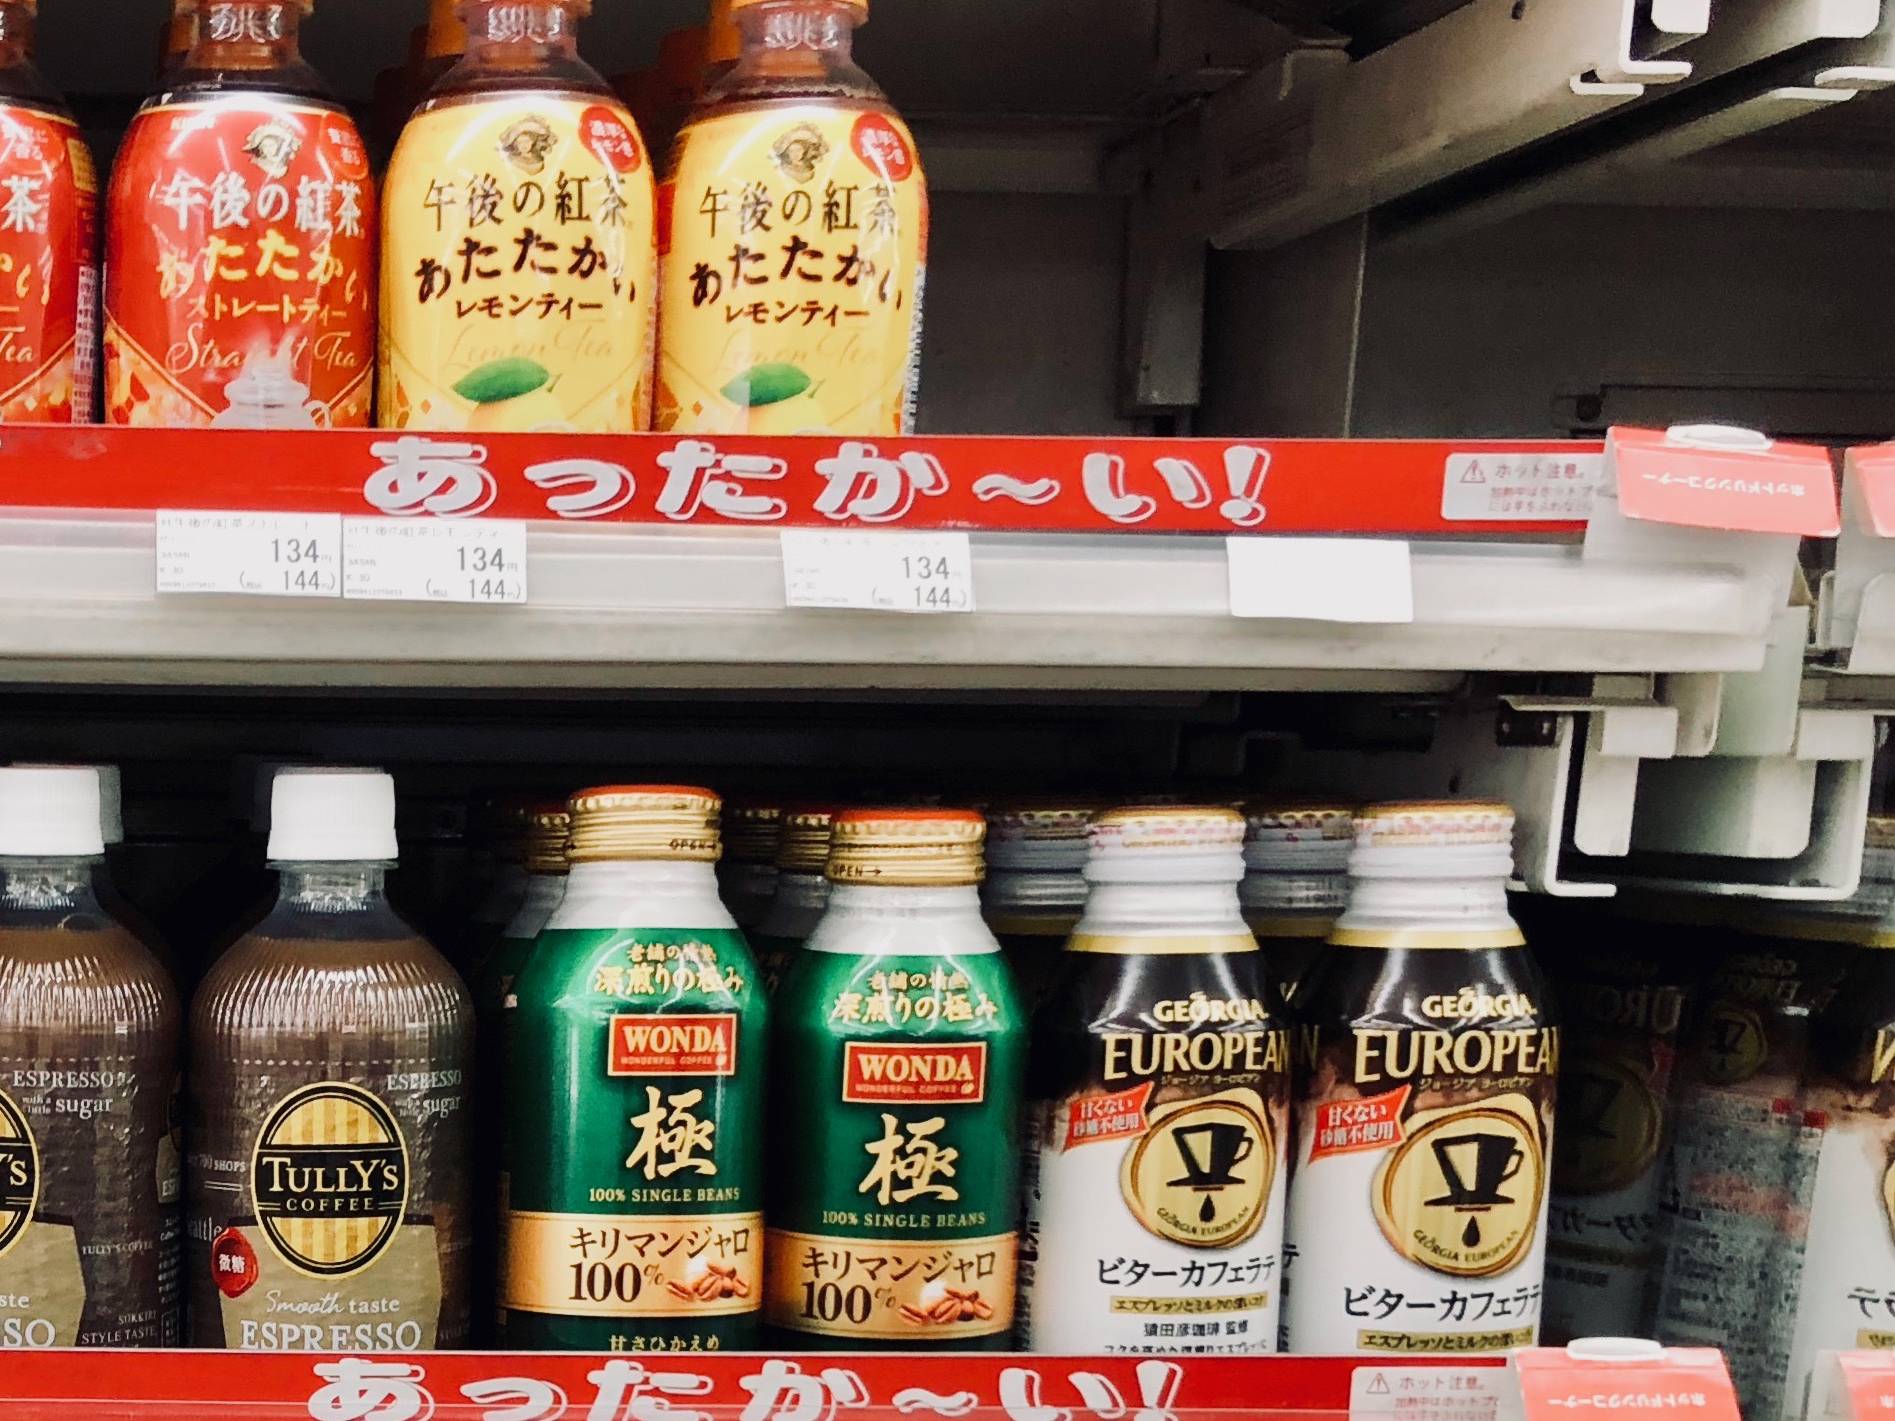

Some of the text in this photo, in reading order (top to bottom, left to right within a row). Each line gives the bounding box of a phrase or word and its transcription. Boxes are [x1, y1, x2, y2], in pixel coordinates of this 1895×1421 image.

[162, 170, 365, 238] 午後の紅茶
[423, 172, 631, 232] 午後の紅茶
[699, 182, 902, 238] 午後の紅茶
[414, 227, 636, 304] あたたかい
[689, 235, 903, 309] あたたかい
[187, 294, 348, 324] ストレートティー
[455, 292, 604, 321] レモンティー
[725, 299, 870, 328] レモンティー
[622, 1024, 727, 1054] WONDA
[12, 1068, 115, 1090] ESPRESSO
[856, 1053, 974, 1083] WONDA
[54, 1096, 114, 1119] sugar
[422, 1093, 461, 1118] sugar
[1080, 1098, 1134, 1119] 甘くない
[1327, 1102, 1388, 1125] 甘くない
[624, 1085, 718, 1182] 極
[213, 1160, 246, 1173] SHOPS
[261, 1156, 400, 1193] TULLY'S
[858, 1113, 960, 1206] 極
[285, 1196, 375, 1212] COFFEE
[589, 1186, 741, 1202] 100% SINGLE BEANS
[821, 1209, 987, 1228] 100% SINGLE BEANS
[568, 1226, 750, 1260] キリマンジャロ
[218, 1253, 246, 1275] 微糖
[801, 1246, 996, 1282] キリマンジャロ
[568, 1261, 664, 1304] 100%
[264, 1289, 401, 1315] Smooth taste
[801, 1280, 897, 1325] 100%
[81, 1331, 121, 1346] STYLE
[239, 1318, 422, 1349] ESPRESSO
[608, 1333, 720, 1350] 甘さひかえめ
